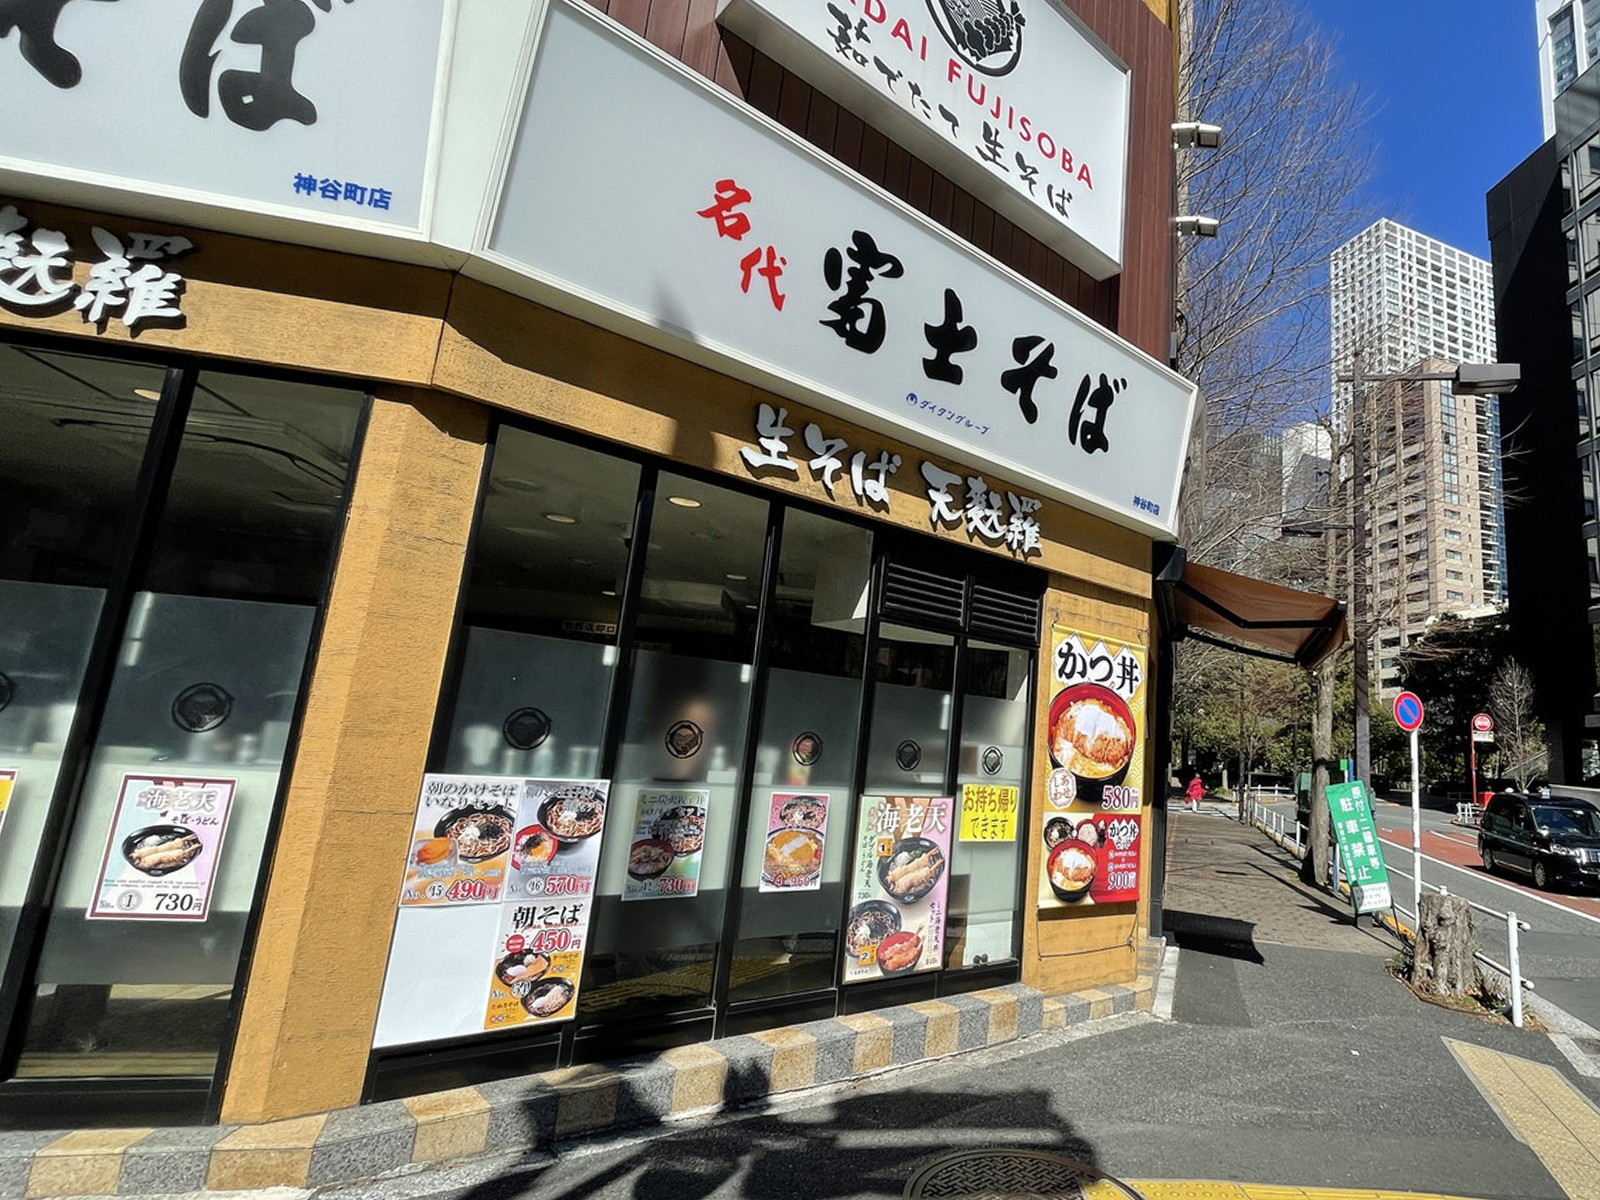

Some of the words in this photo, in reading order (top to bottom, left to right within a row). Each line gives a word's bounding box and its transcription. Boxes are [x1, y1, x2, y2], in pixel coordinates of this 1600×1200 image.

[849, 0, 927, 61] DAI
[947, 58, 1094, 190] FUJISOBA
[293, 172, 392, 211] 神谷町店
[697, 178, 788, 312] 名代
[818, 230, 1128, 455] 富士そば
[919, 399, 992, 436] ダイタングループ
[740, 402, 902, 504] 生そば
[1058, 641, 1139, 694] かつ丼
[428, 781, 519, 798] 朝のかけそば
[963, 786, 1017, 813] お持ち帰り
[876, 802, 946, 834] 海老天
[1339, 797, 1372, 881] 駐車禁止
[155, 893, 203, 912] 730円
[512, 903, 584, 930] 朝そば
